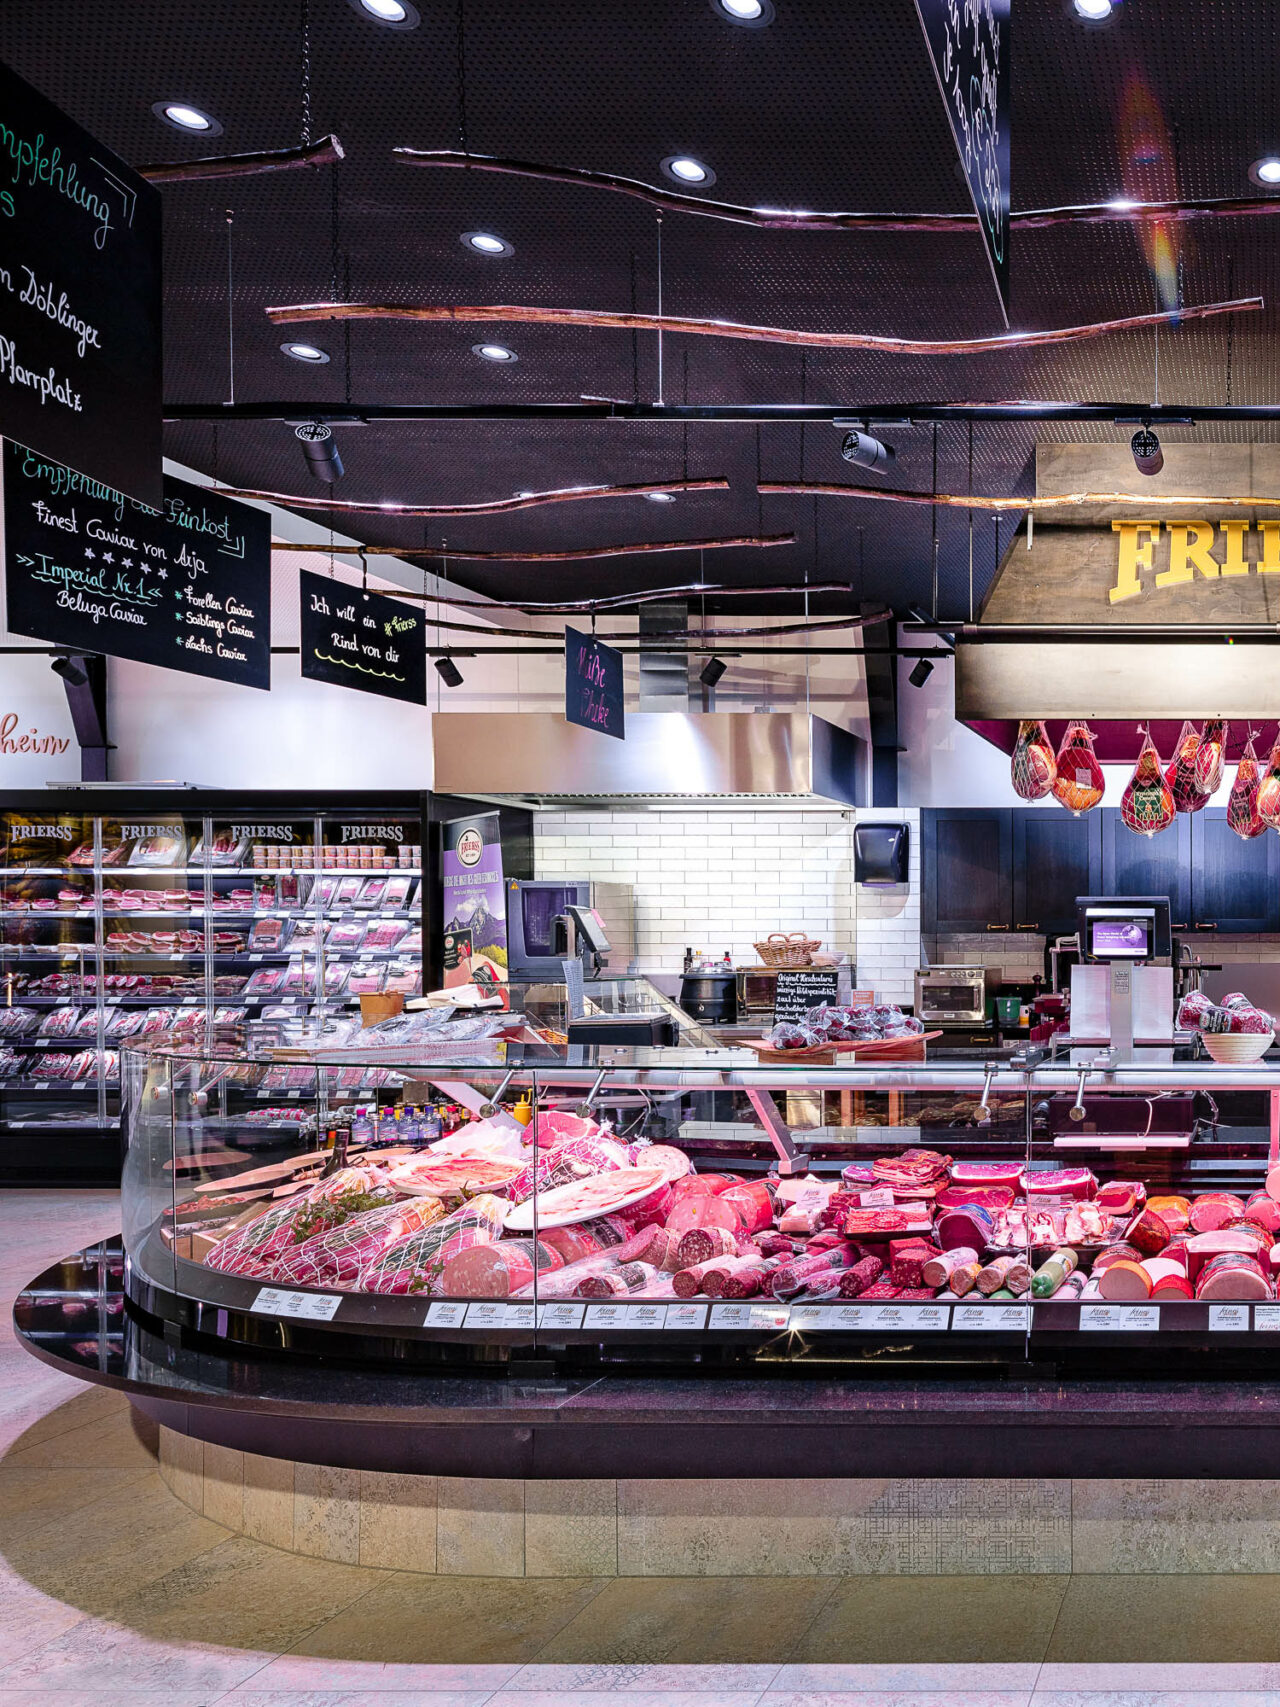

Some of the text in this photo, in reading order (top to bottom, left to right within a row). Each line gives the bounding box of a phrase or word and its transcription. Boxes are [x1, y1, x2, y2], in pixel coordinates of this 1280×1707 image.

[20, 264, 101, 358] Döblinger
[0, 334, 83, 412] Pfarrplatz
[32, 500, 79, 533] Finest
[86, 519, 139, 550] Caviar
[143, 541, 167, 560] von
[35, 552, 108, 590] Imperial
[56, 589, 148, 626] Beluga Caviar
[310, 594, 331, 616] Ich
[336, 604, 356, 622] will
[363, 615, 377, 629] ein
[330, 632, 400, 663] Rind von dir
[10, 825, 73, 843] FRIERSS
[120, 825, 183, 843] FRIERSS
[231, 825, 293, 843] FRIERSS
[340, 825, 404, 844] FRIERSS
